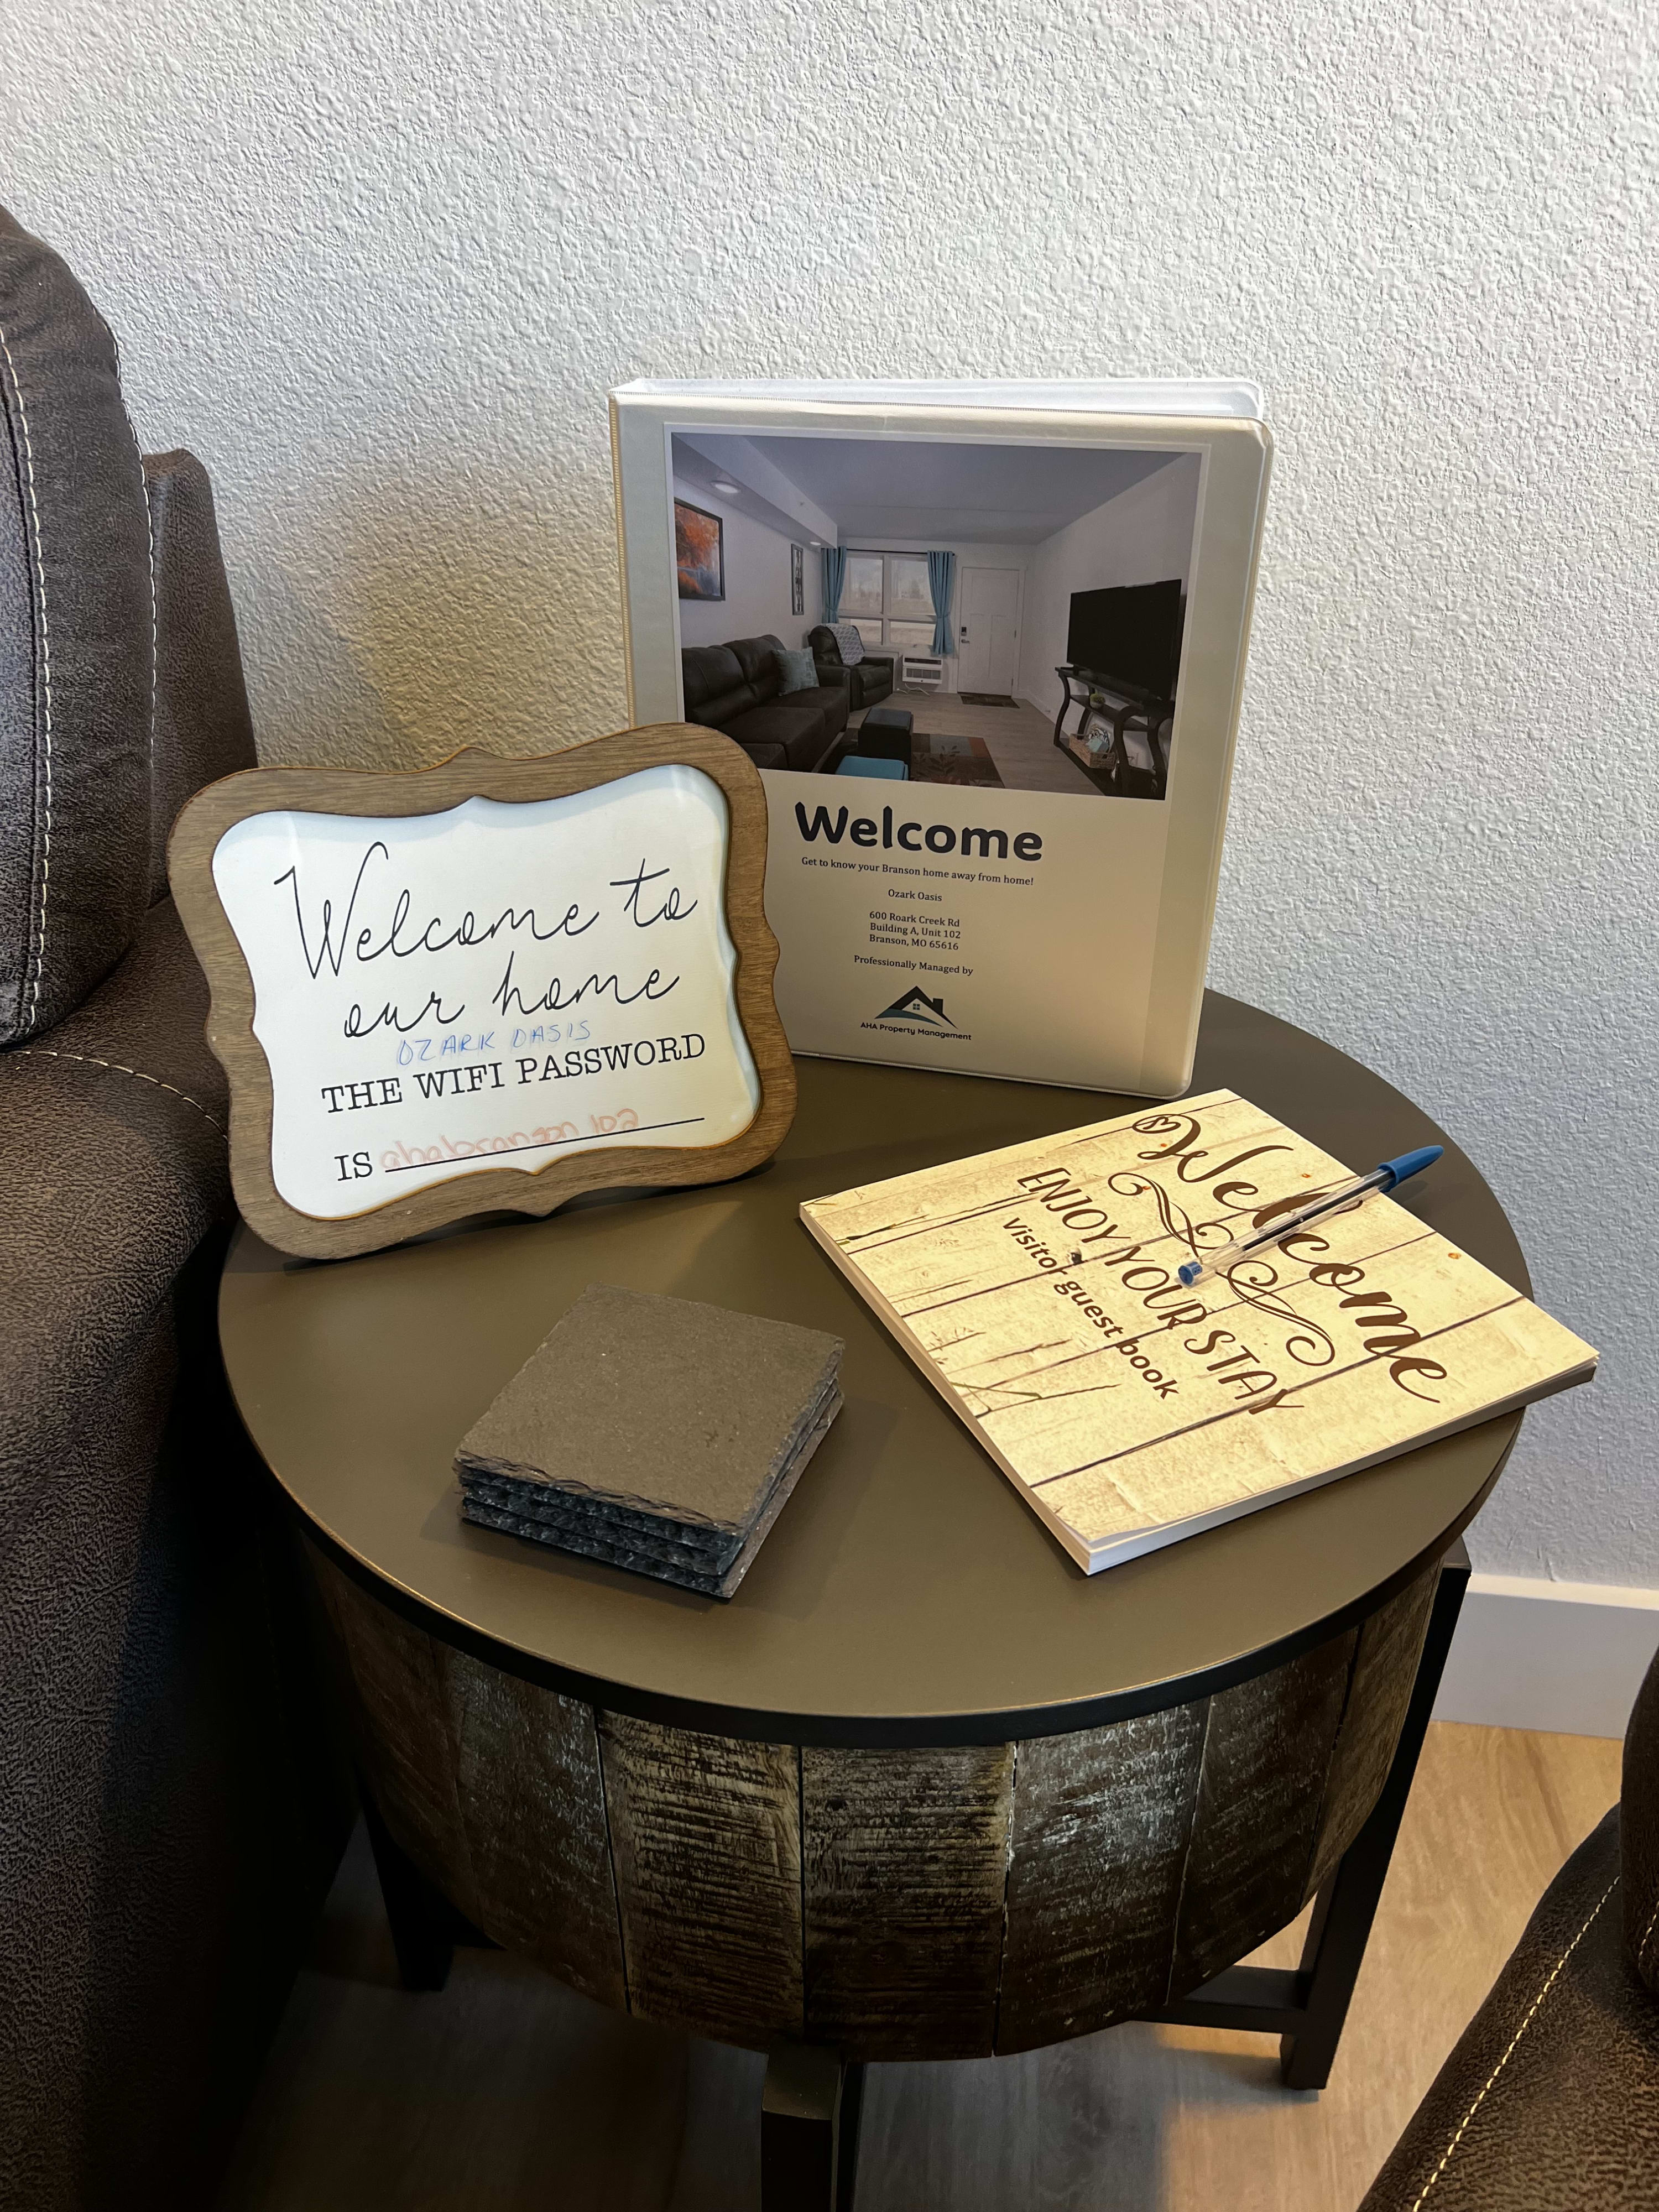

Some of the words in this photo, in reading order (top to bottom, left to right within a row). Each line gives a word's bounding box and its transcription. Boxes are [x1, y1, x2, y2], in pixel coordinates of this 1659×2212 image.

[795, 801, 1043, 862] Welcome
[801, 857, 817, 866] Get
[831, 859, 856, 870] know
[858, 864, 880, 873] your
[882, 864, 921, 876] Branson
[923, 868, 950, 879] home
[951, 871, 976, 882] away
[978, 873, 1001, 883] from
[1004, 875, 1034, 885] home!
[888, 889, 915, 900] Ozark
[917, 891, 942, 902] Oasis
[273, 841, 600, 980] Welcome
[609, 858, 698, 928] to
[869, 911, 887, 921] 600
[889, 912, 917, 924] Roark
[919, 915, 946, 926] Creek
[948, 918, 960, 927] Rd
[869, 934, 909, 947] Branson,
[911, 938, 927, 947] MO
[929, 940, 959, 951] 65616
[870, 922, 908, 936] Building
[910, 927, 920, 936] A,
[921, 928, 941, 937] Unit
[944, 930, 961, 939] 102
[854, 955, 917, 970] Professionally
[919, 962, 959, 975] Managed
[962, 967, 974, 976] by
[343, 992, 465, 1039] our
[492, 950, 680, 1017] home
[880, 1024, 915, 1035] Property
[917, 1029, 972, 1040] Management
[397, 1031, 495, 1066] OZARK
[321, 1077, 403, 1114] THE
[413, 1062, 507, 1098] WIFI
[515, 1034, 706, 1085] PASSWORD
[590, 1108, 639, 1135] 102
[334, 1152, 373, 1181] IS
[1016, 1167, 1131, 1244] ENJOY
[1104, 1246, 1208, 1330] YOUR
[1184, 1329, 1305, 1415] STAY
[1003, 1217, 1068, 1275] Visitor
[1053, 1281, 1124, 1338] guest
[1115, 1339, 1180, 1400] book
